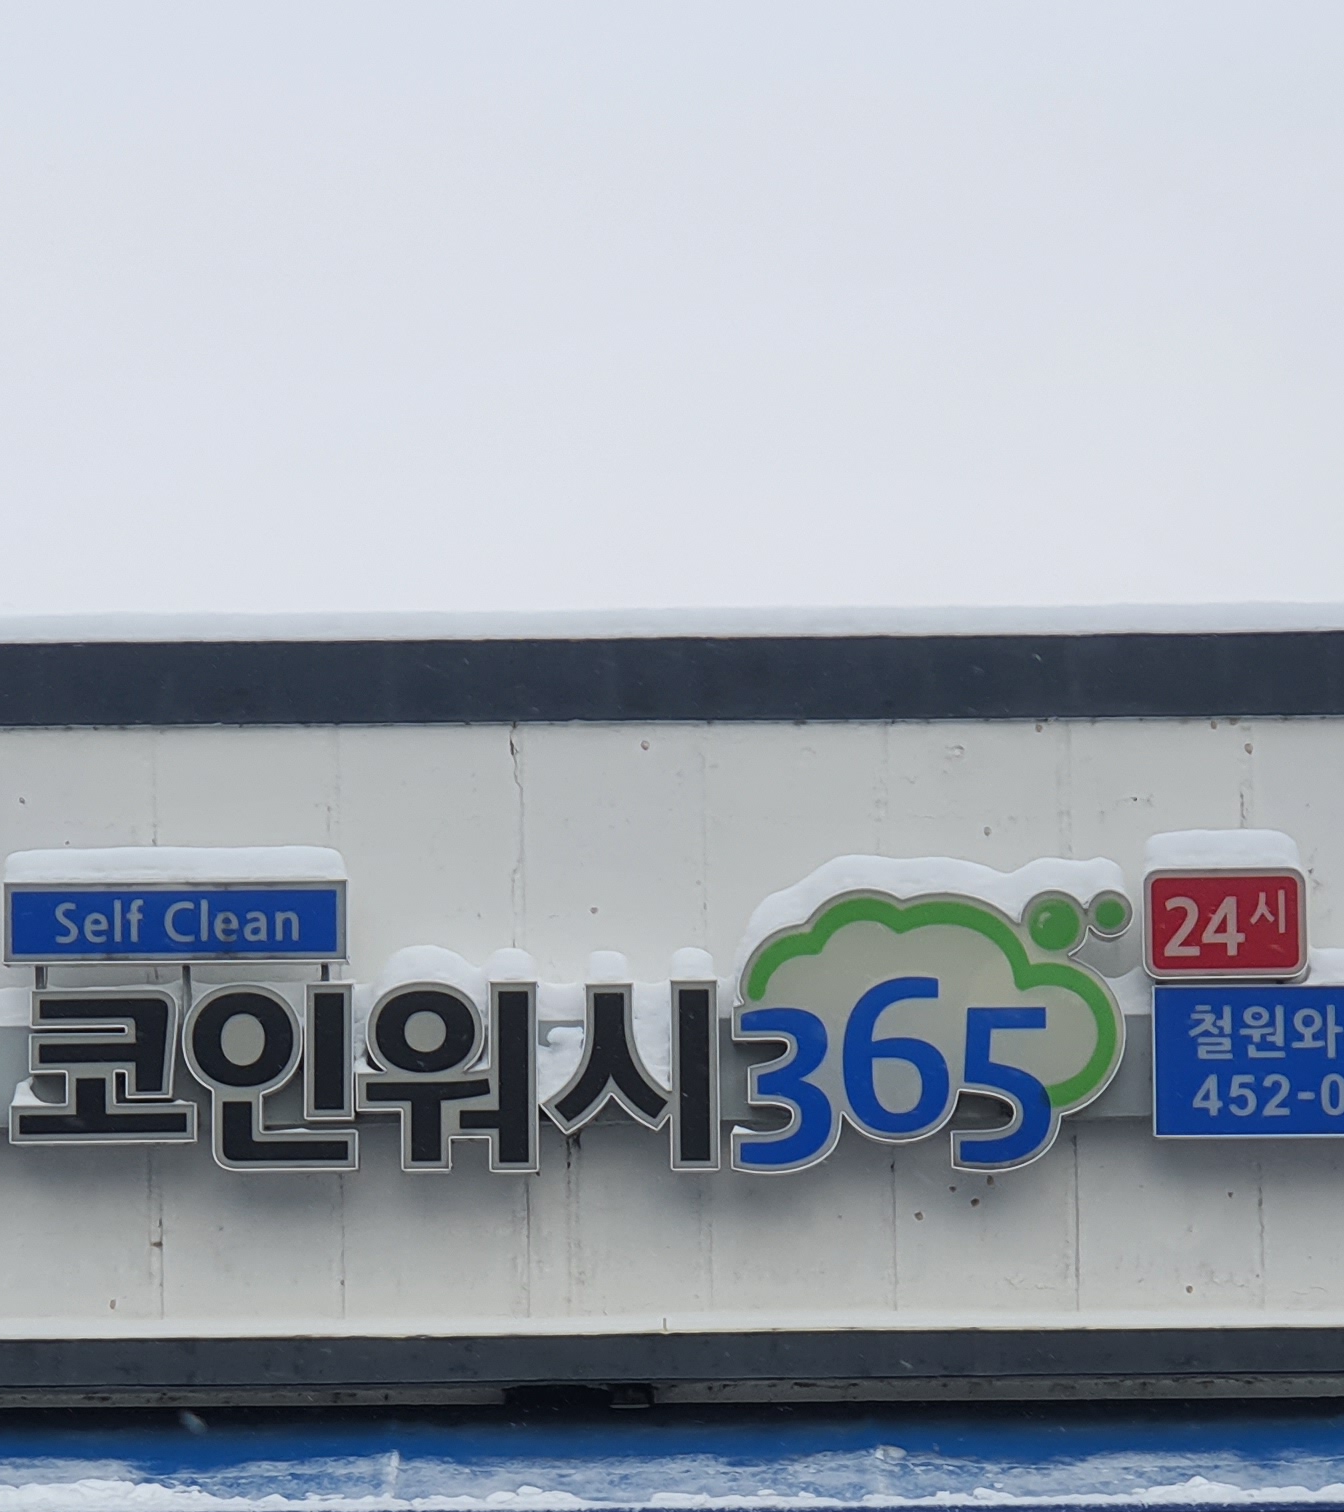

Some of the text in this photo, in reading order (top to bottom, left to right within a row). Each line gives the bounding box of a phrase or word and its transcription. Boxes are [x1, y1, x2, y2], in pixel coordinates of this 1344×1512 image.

[55, 898, 300, 944] Self Clean
[1164, 889, 1286, 957] 24시
